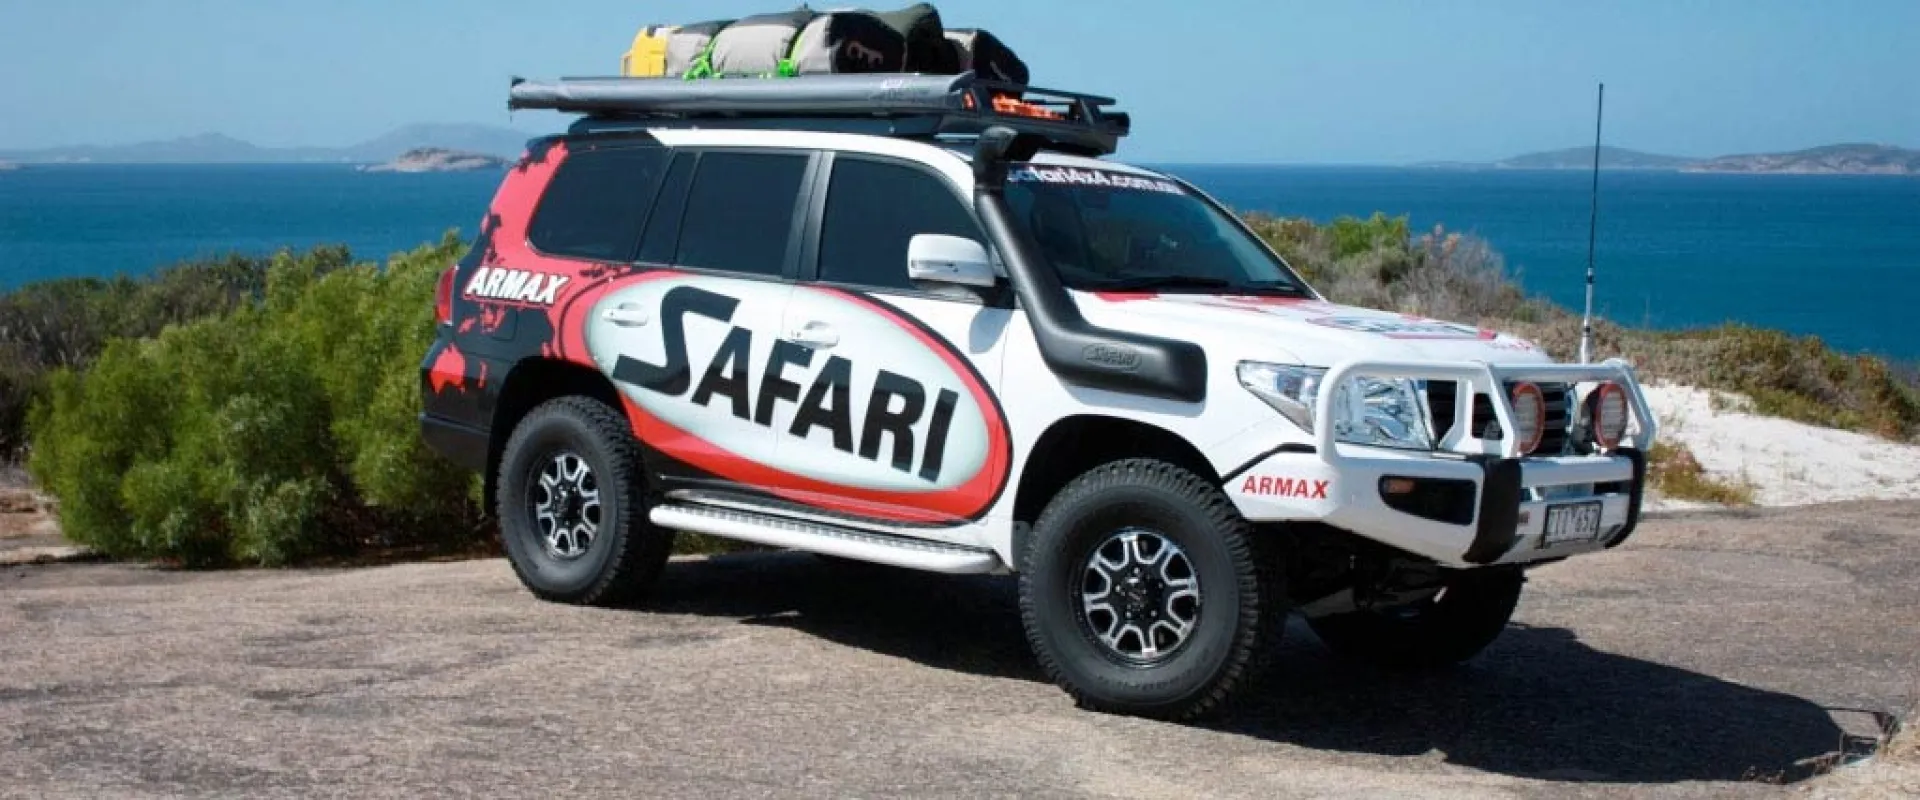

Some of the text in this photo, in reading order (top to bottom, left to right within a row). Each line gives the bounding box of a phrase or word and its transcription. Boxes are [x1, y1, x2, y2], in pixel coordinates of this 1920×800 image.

[465, 266, 571, 304] ARMAX
[612, 285, 960, 484] SAFARI
[1242, 475, 1331, 499] ARMAX
